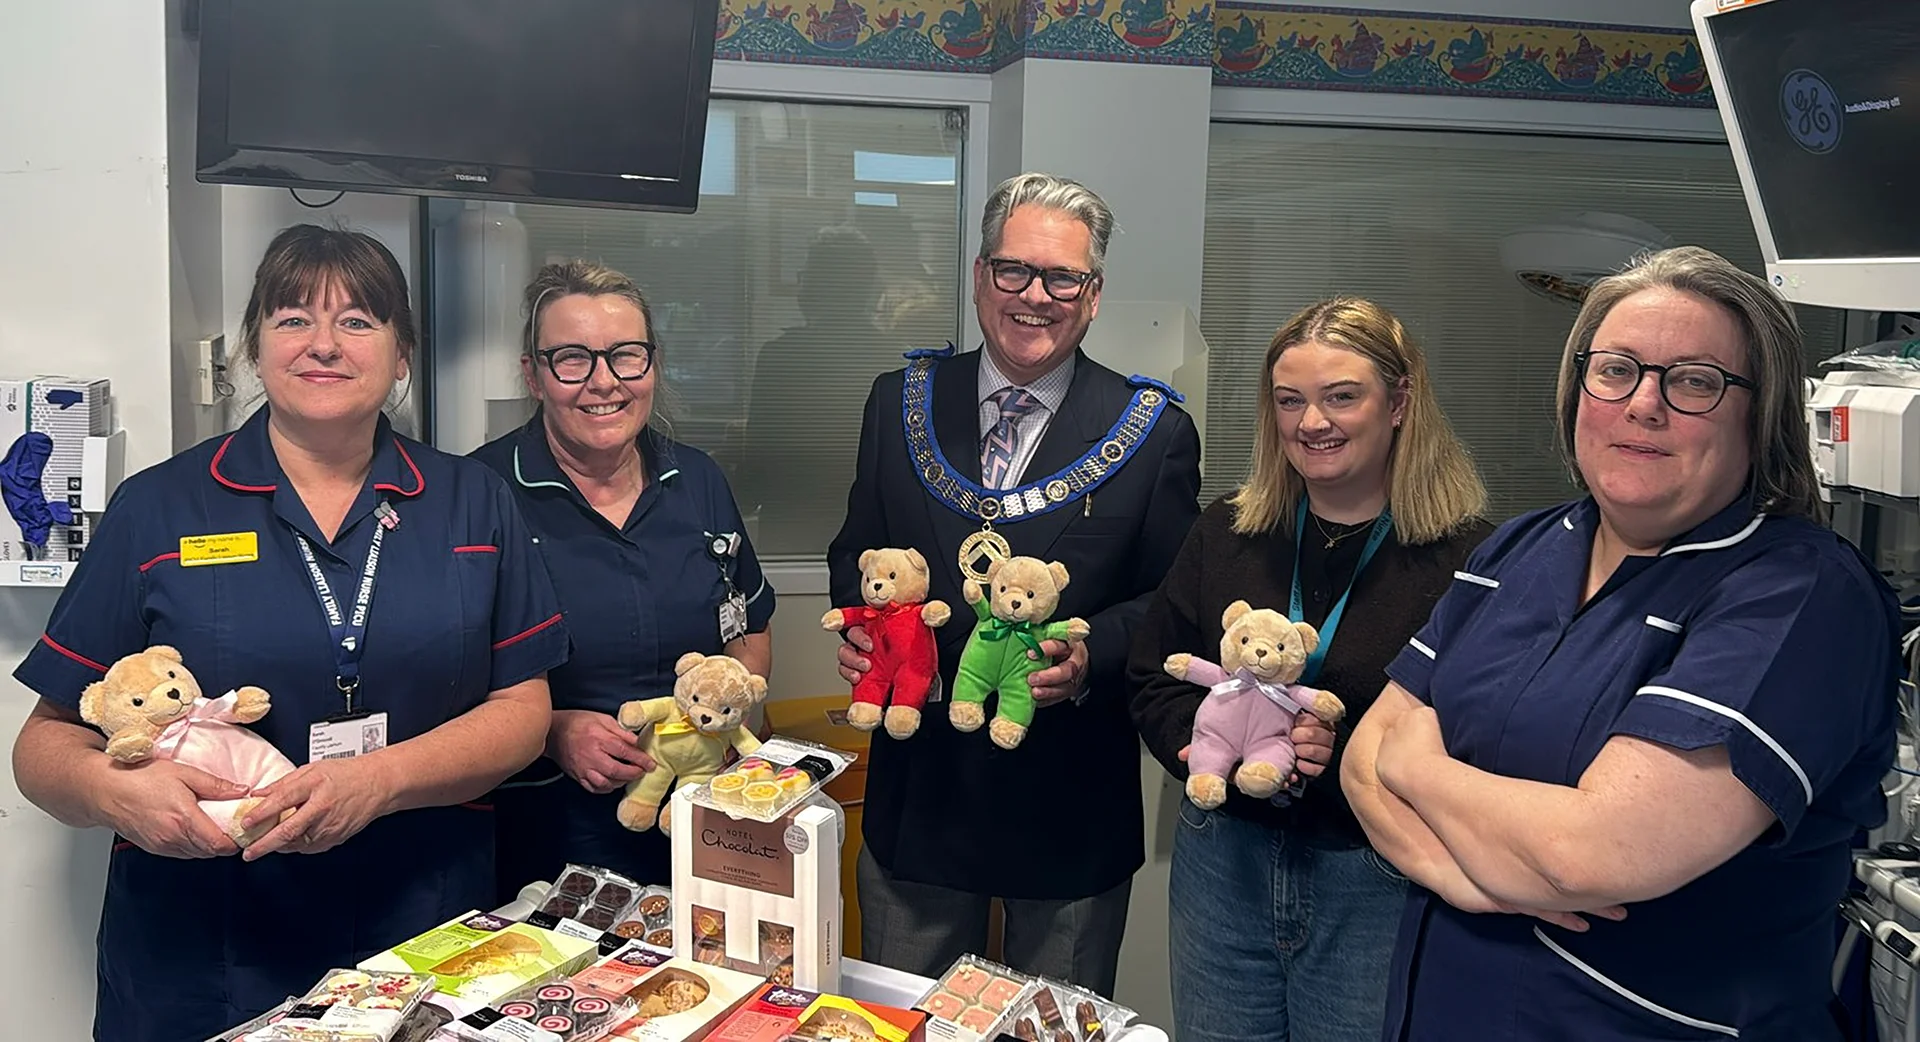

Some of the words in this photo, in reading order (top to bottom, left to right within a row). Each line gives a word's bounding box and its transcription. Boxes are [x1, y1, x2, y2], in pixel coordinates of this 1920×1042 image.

[455, 174, 488, 182] TOSHIBA
[373, 521, 384, 546] AMILY
[208, 546, 230, 554] Sarah
[364, 545, 380, 577] LIAISON
[308, 562, 331, 595] LIAISON
[357, 576, 374, 605] NURSE
[322, 595, 342, 626] FAMILY
[352, 604, 367, 627] PICU
[725, 828, 754, 841] HOTEL
[722, 865, 761, 878] EVERYTHING
